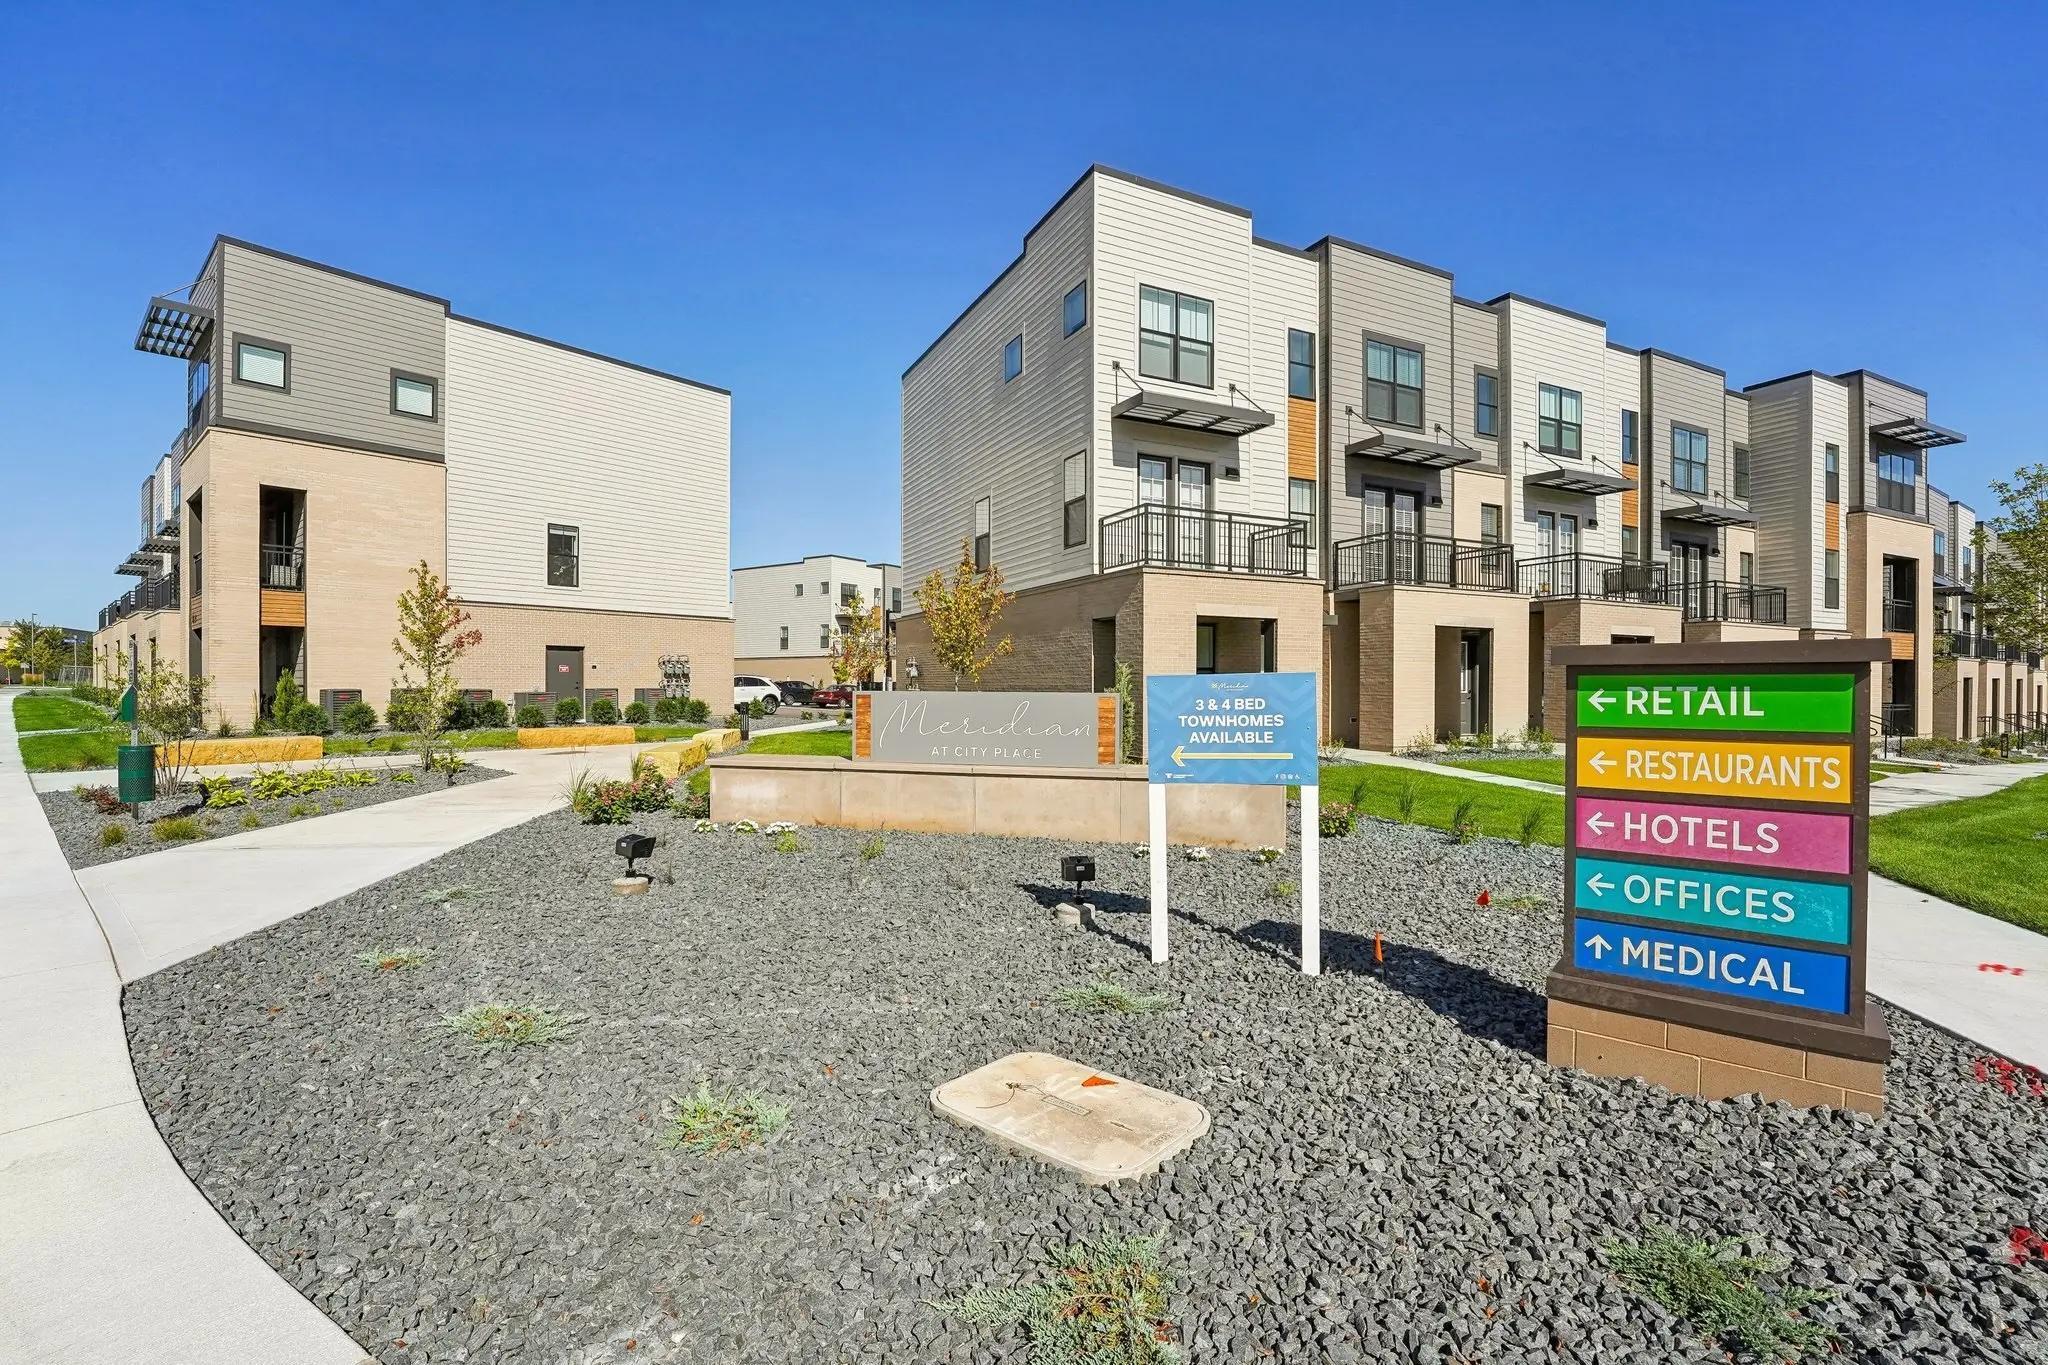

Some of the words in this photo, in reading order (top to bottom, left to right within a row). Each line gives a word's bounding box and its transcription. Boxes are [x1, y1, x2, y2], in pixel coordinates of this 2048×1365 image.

[1195, 700, 1204, 711] 3
[1208, 699, 1218, 711] &
[1221, 699, 1231, 711] 4
[1234, 698, 1266, 710] BED
[1626, 686, 1765, 717] RETAIL
[879, 699, 1091, 750] Meridian
[1178, 714, 1284, 728] TOWNHOMES
[1189, 731, 1274, 744] AVAILABLE
[930, 746, 948, 757] AT
[954, 746, 988, 757] CITY
[994, 747, 1042, 759] PLACE
[1626, 750, 1841, 790] RESTAURANTS
[1624, 812, 1780, 854] HOTELS
[1623, 875, 1796, 923] OFFICES
[1622, 937, 1805, 996] MEDICAL
